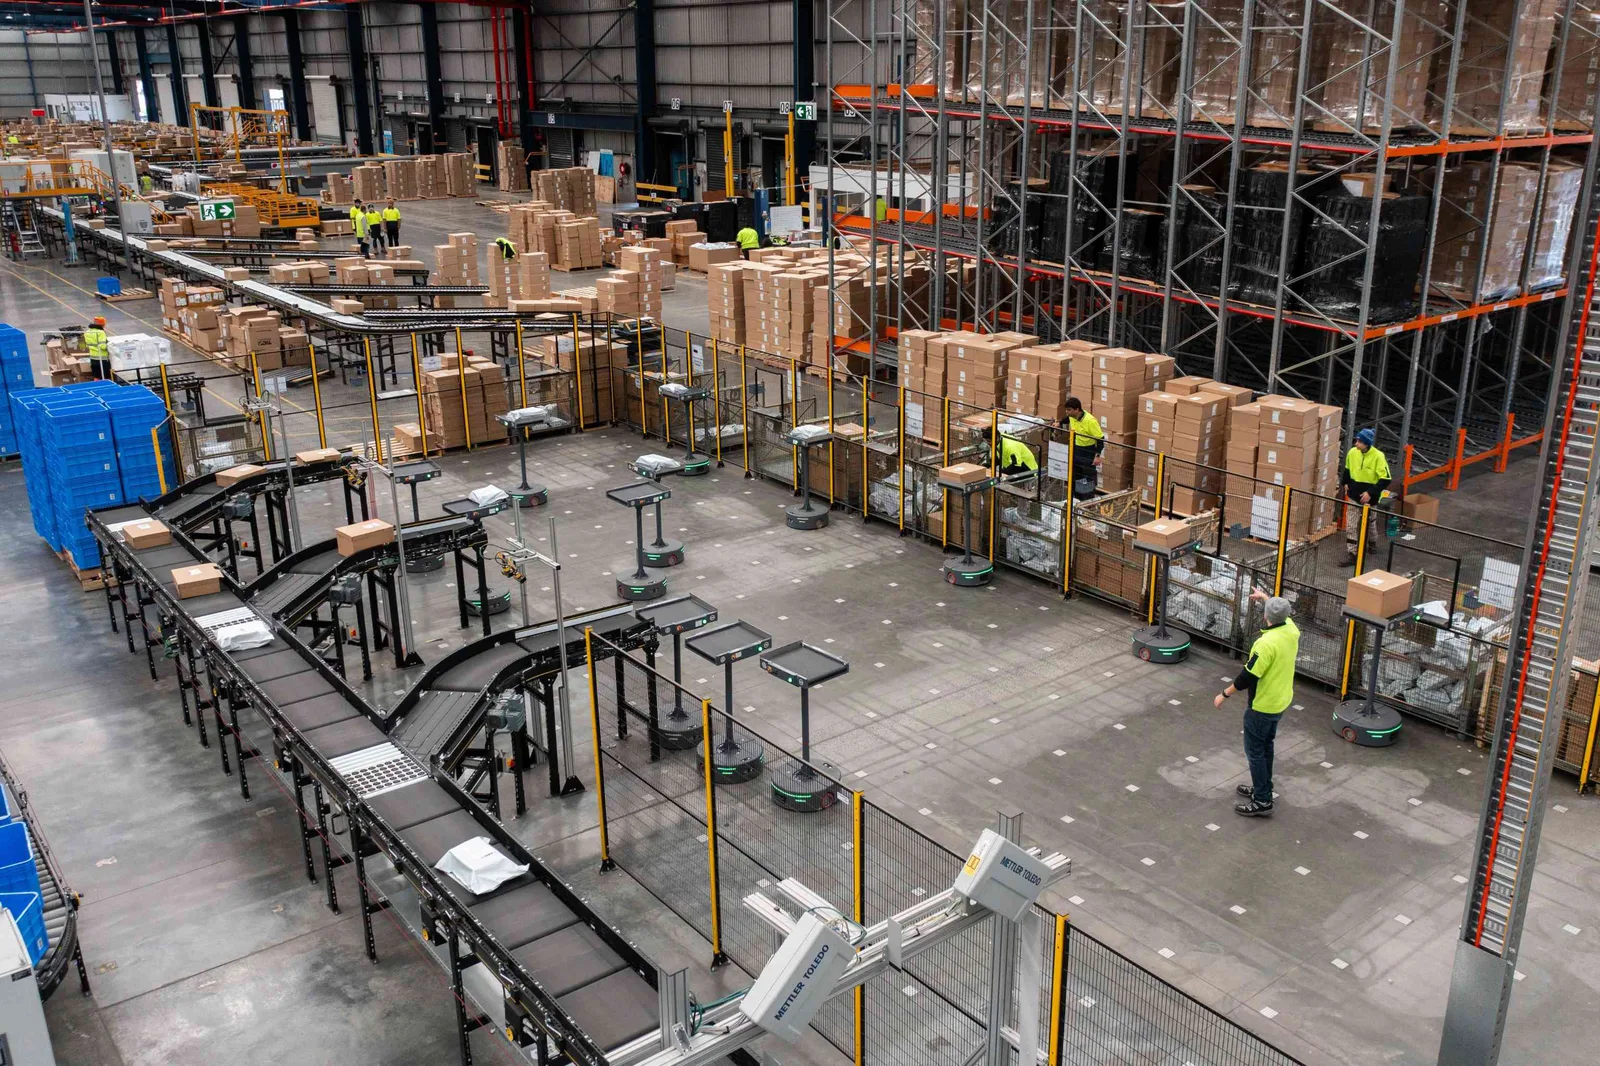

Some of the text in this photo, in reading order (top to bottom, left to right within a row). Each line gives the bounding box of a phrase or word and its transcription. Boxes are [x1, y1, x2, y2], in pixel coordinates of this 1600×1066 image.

[723, 101, 732, 111] 07
[780, 102, 790, 113] 08
[1000, 856, 1042, 886] METTLER TOLEDO
[774, 944, 829, 1021] METTLER TOLEDO
